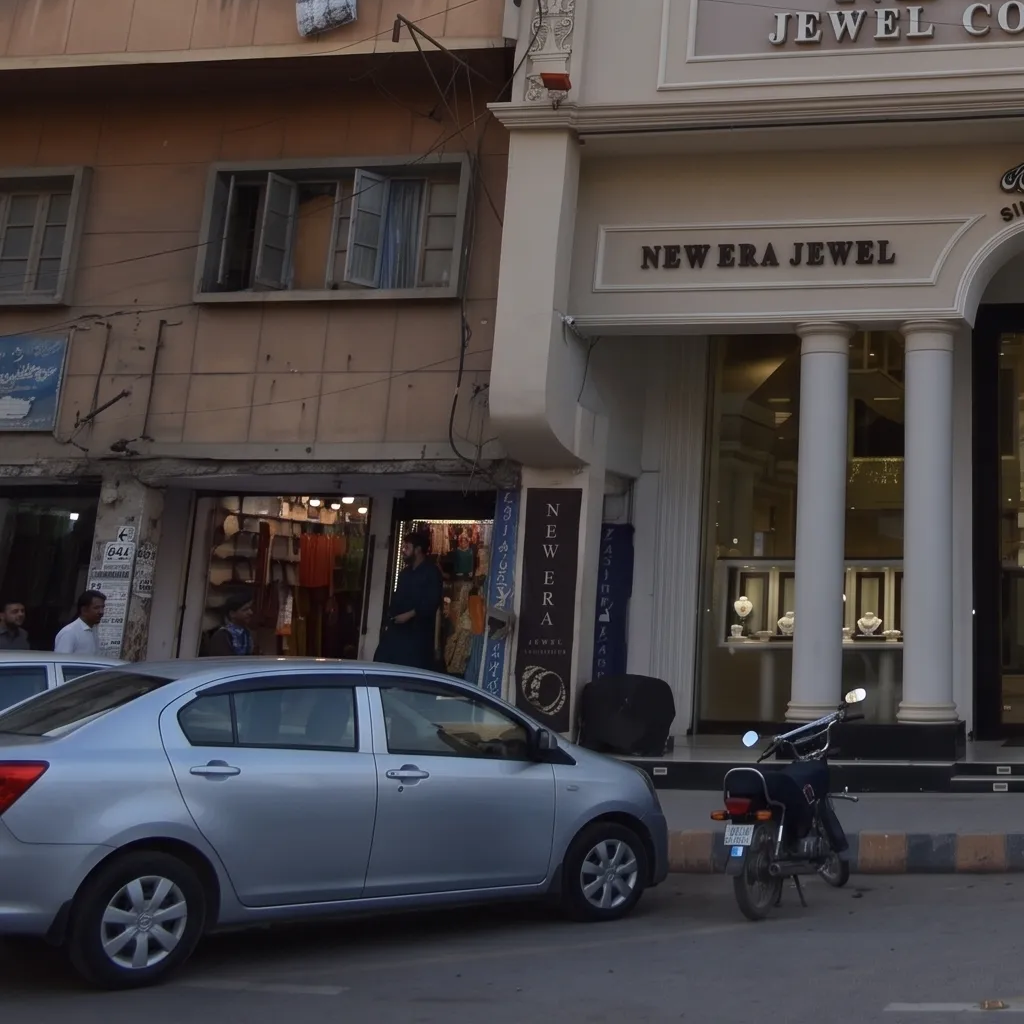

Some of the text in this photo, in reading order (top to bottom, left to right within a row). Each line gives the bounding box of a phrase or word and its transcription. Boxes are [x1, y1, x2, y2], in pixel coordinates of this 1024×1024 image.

[768, 5, 935, 46] JEWEL
[640, 239, 897, 270] NEW ERA JEWEL
[540, 502, 561, 626] NEW ERA
